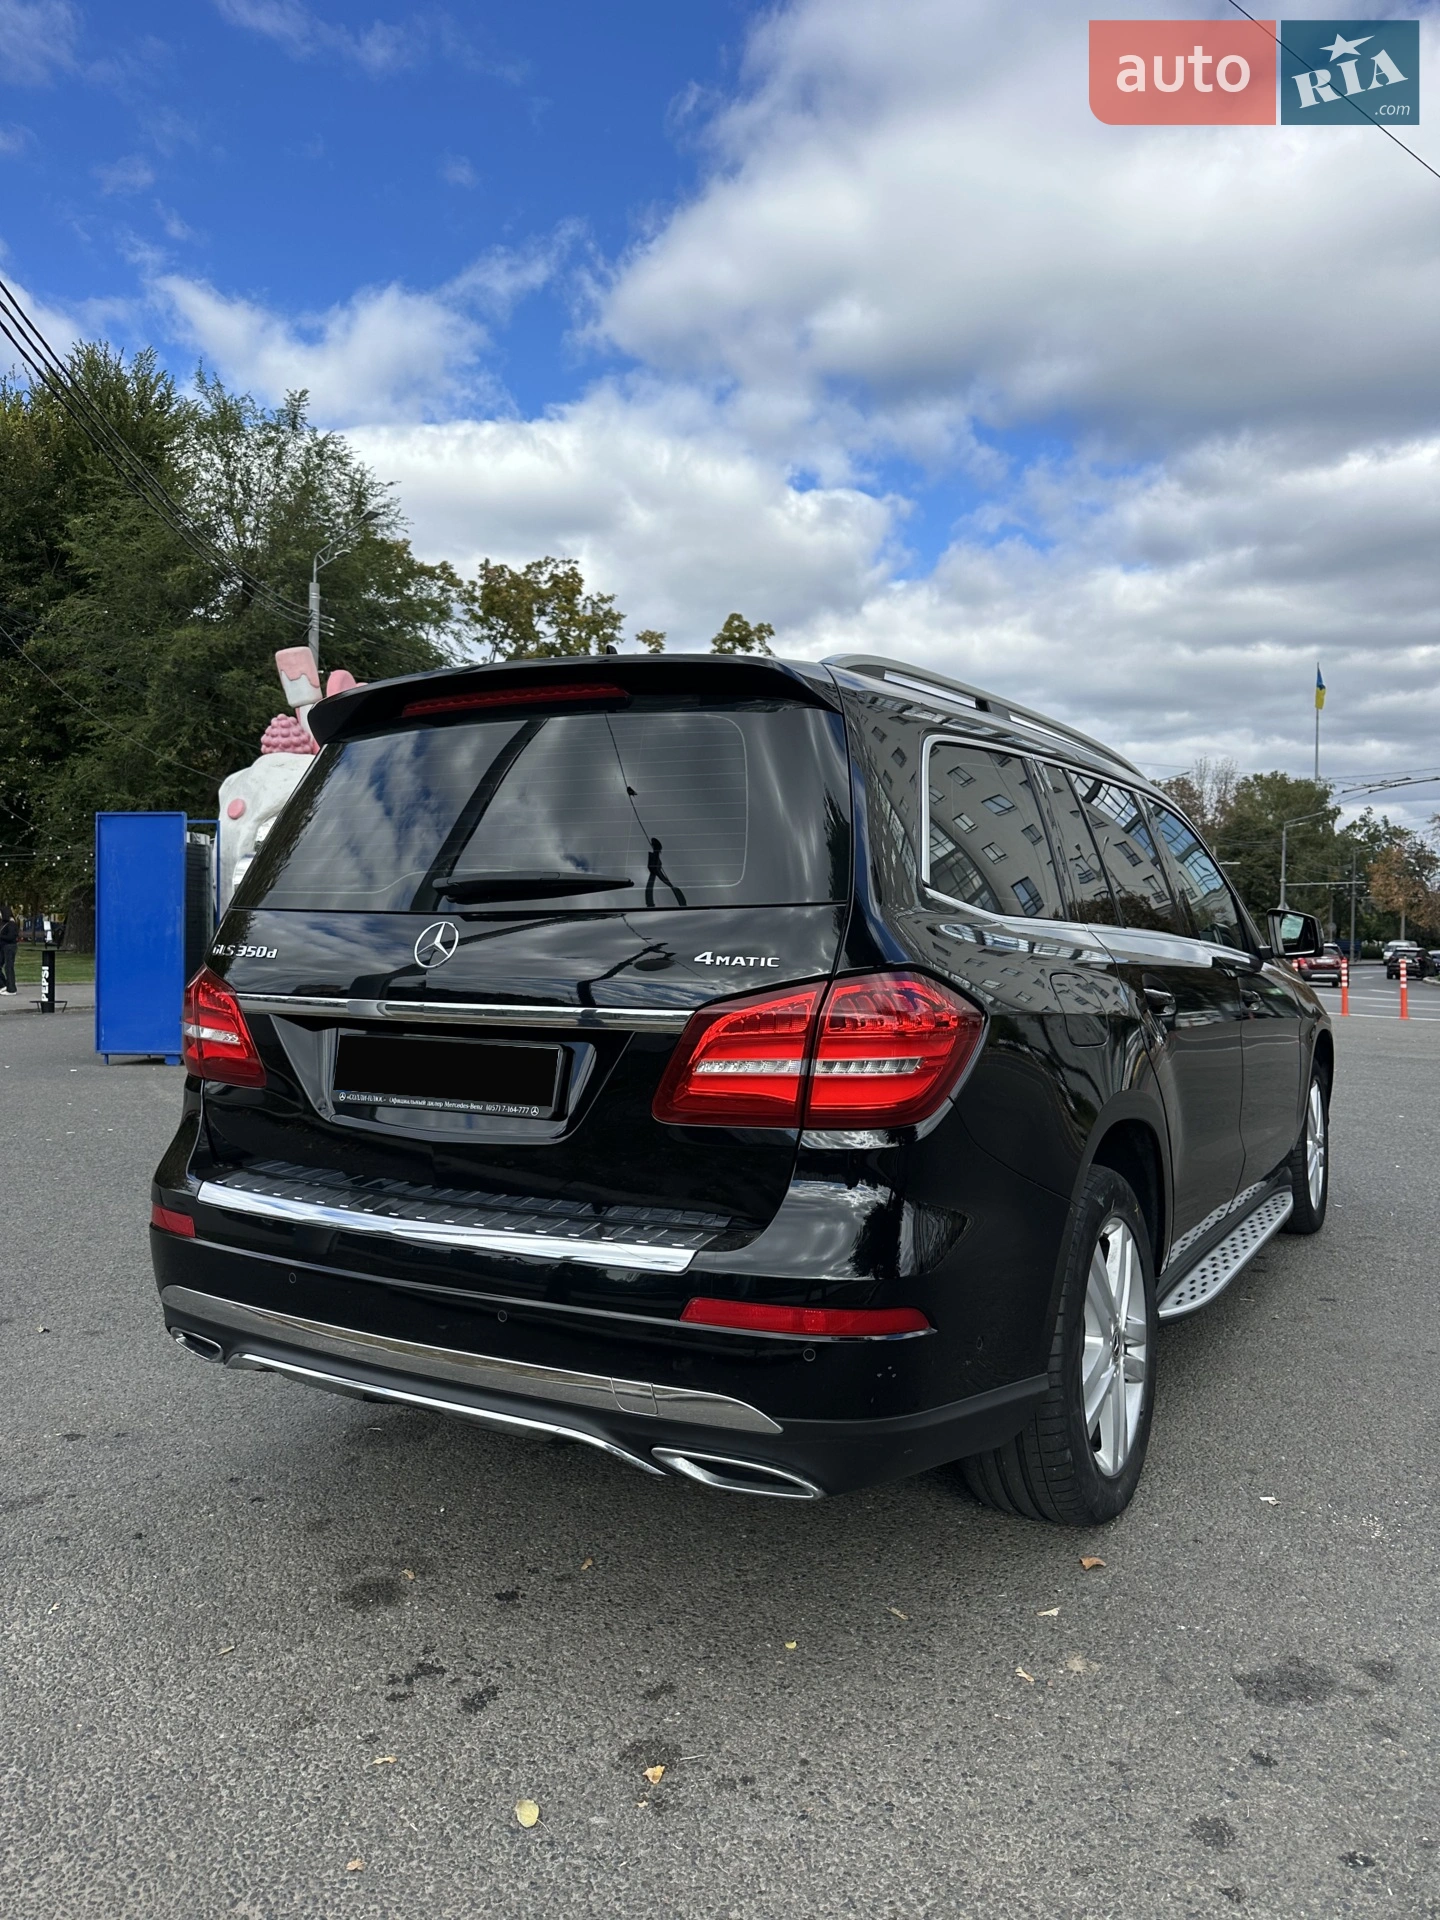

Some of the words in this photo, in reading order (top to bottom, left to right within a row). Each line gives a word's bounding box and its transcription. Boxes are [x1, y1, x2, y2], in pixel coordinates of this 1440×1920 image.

[212, 944, 236, 956] GLS
[236, 946, 278, 959] 350d
[693, 951, 780, 968] 4MATIC
[41, 966, 49, 1001] PEPSI
[444, 1102, 484, 1111] Mercedes-Benz
[486, 1104, 502, 1112] (057)
[502, 1105, 530, 1114] 7-164-777
